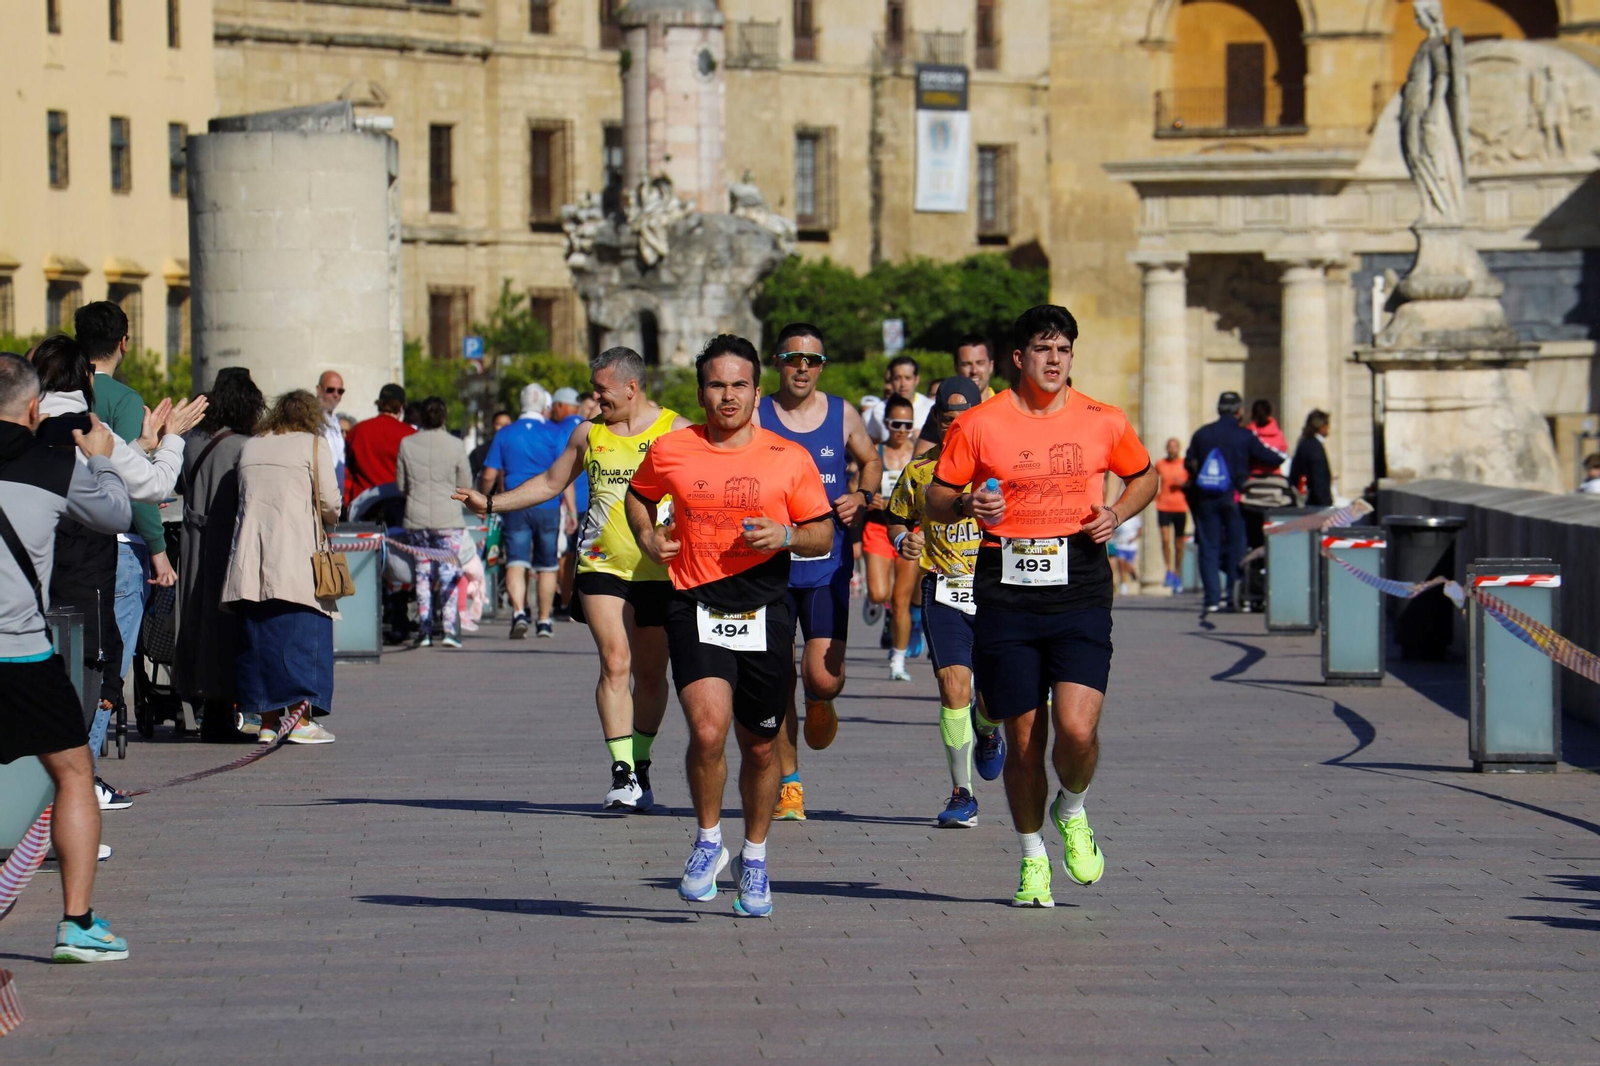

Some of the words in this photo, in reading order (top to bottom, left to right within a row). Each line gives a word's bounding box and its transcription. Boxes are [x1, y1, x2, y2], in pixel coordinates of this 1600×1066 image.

[466, 338, 478, 357] P
[820, 473, 837, 484] RRA
[1012, 509, 1048, 517] CARRERA
[1048, 508, 1083, 516] POPULAR
[1015, 517, 1046, 525] PUENTE
[1047, 516, 1080, 524] ROMANO
[1015, 558, 1051, 572] 493
[711, 623, 749, 637] 494
